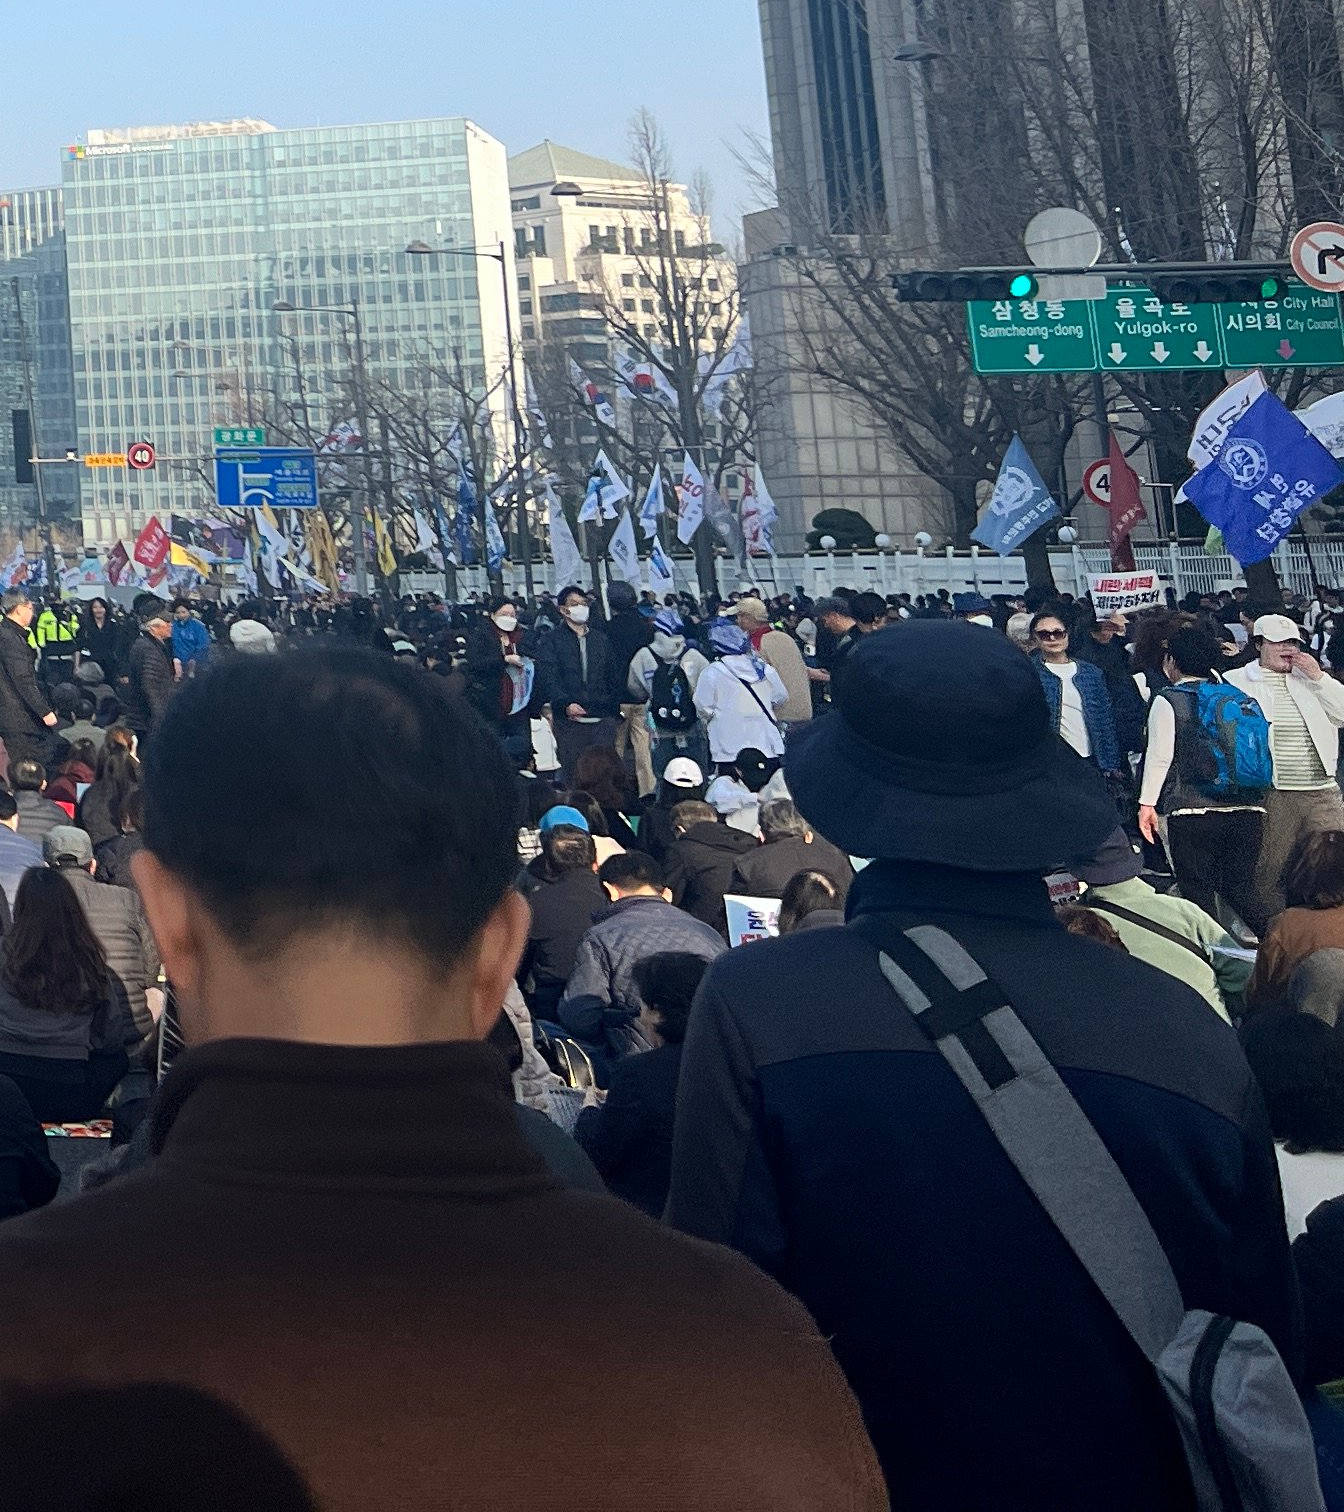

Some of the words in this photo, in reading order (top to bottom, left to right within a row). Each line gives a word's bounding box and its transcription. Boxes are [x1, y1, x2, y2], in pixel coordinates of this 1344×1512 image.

[991, 300, 1066, 320] 삼청동
[1283, 296, 1307, 311] City
[1311, 295, 1335, 308] Hall
[1114, 320, 1198, 336] Yulgok-ro
[1226, 312, 1282, 331] 시의회
[1307, 317, 1339, 330] Council
[979, 324, 1084, 339] Samcheong-dong
[220, 430, 258, 442] 광화문
[134, 451, 149, 463] 40
[1097, 473, 1111, 493] 4
